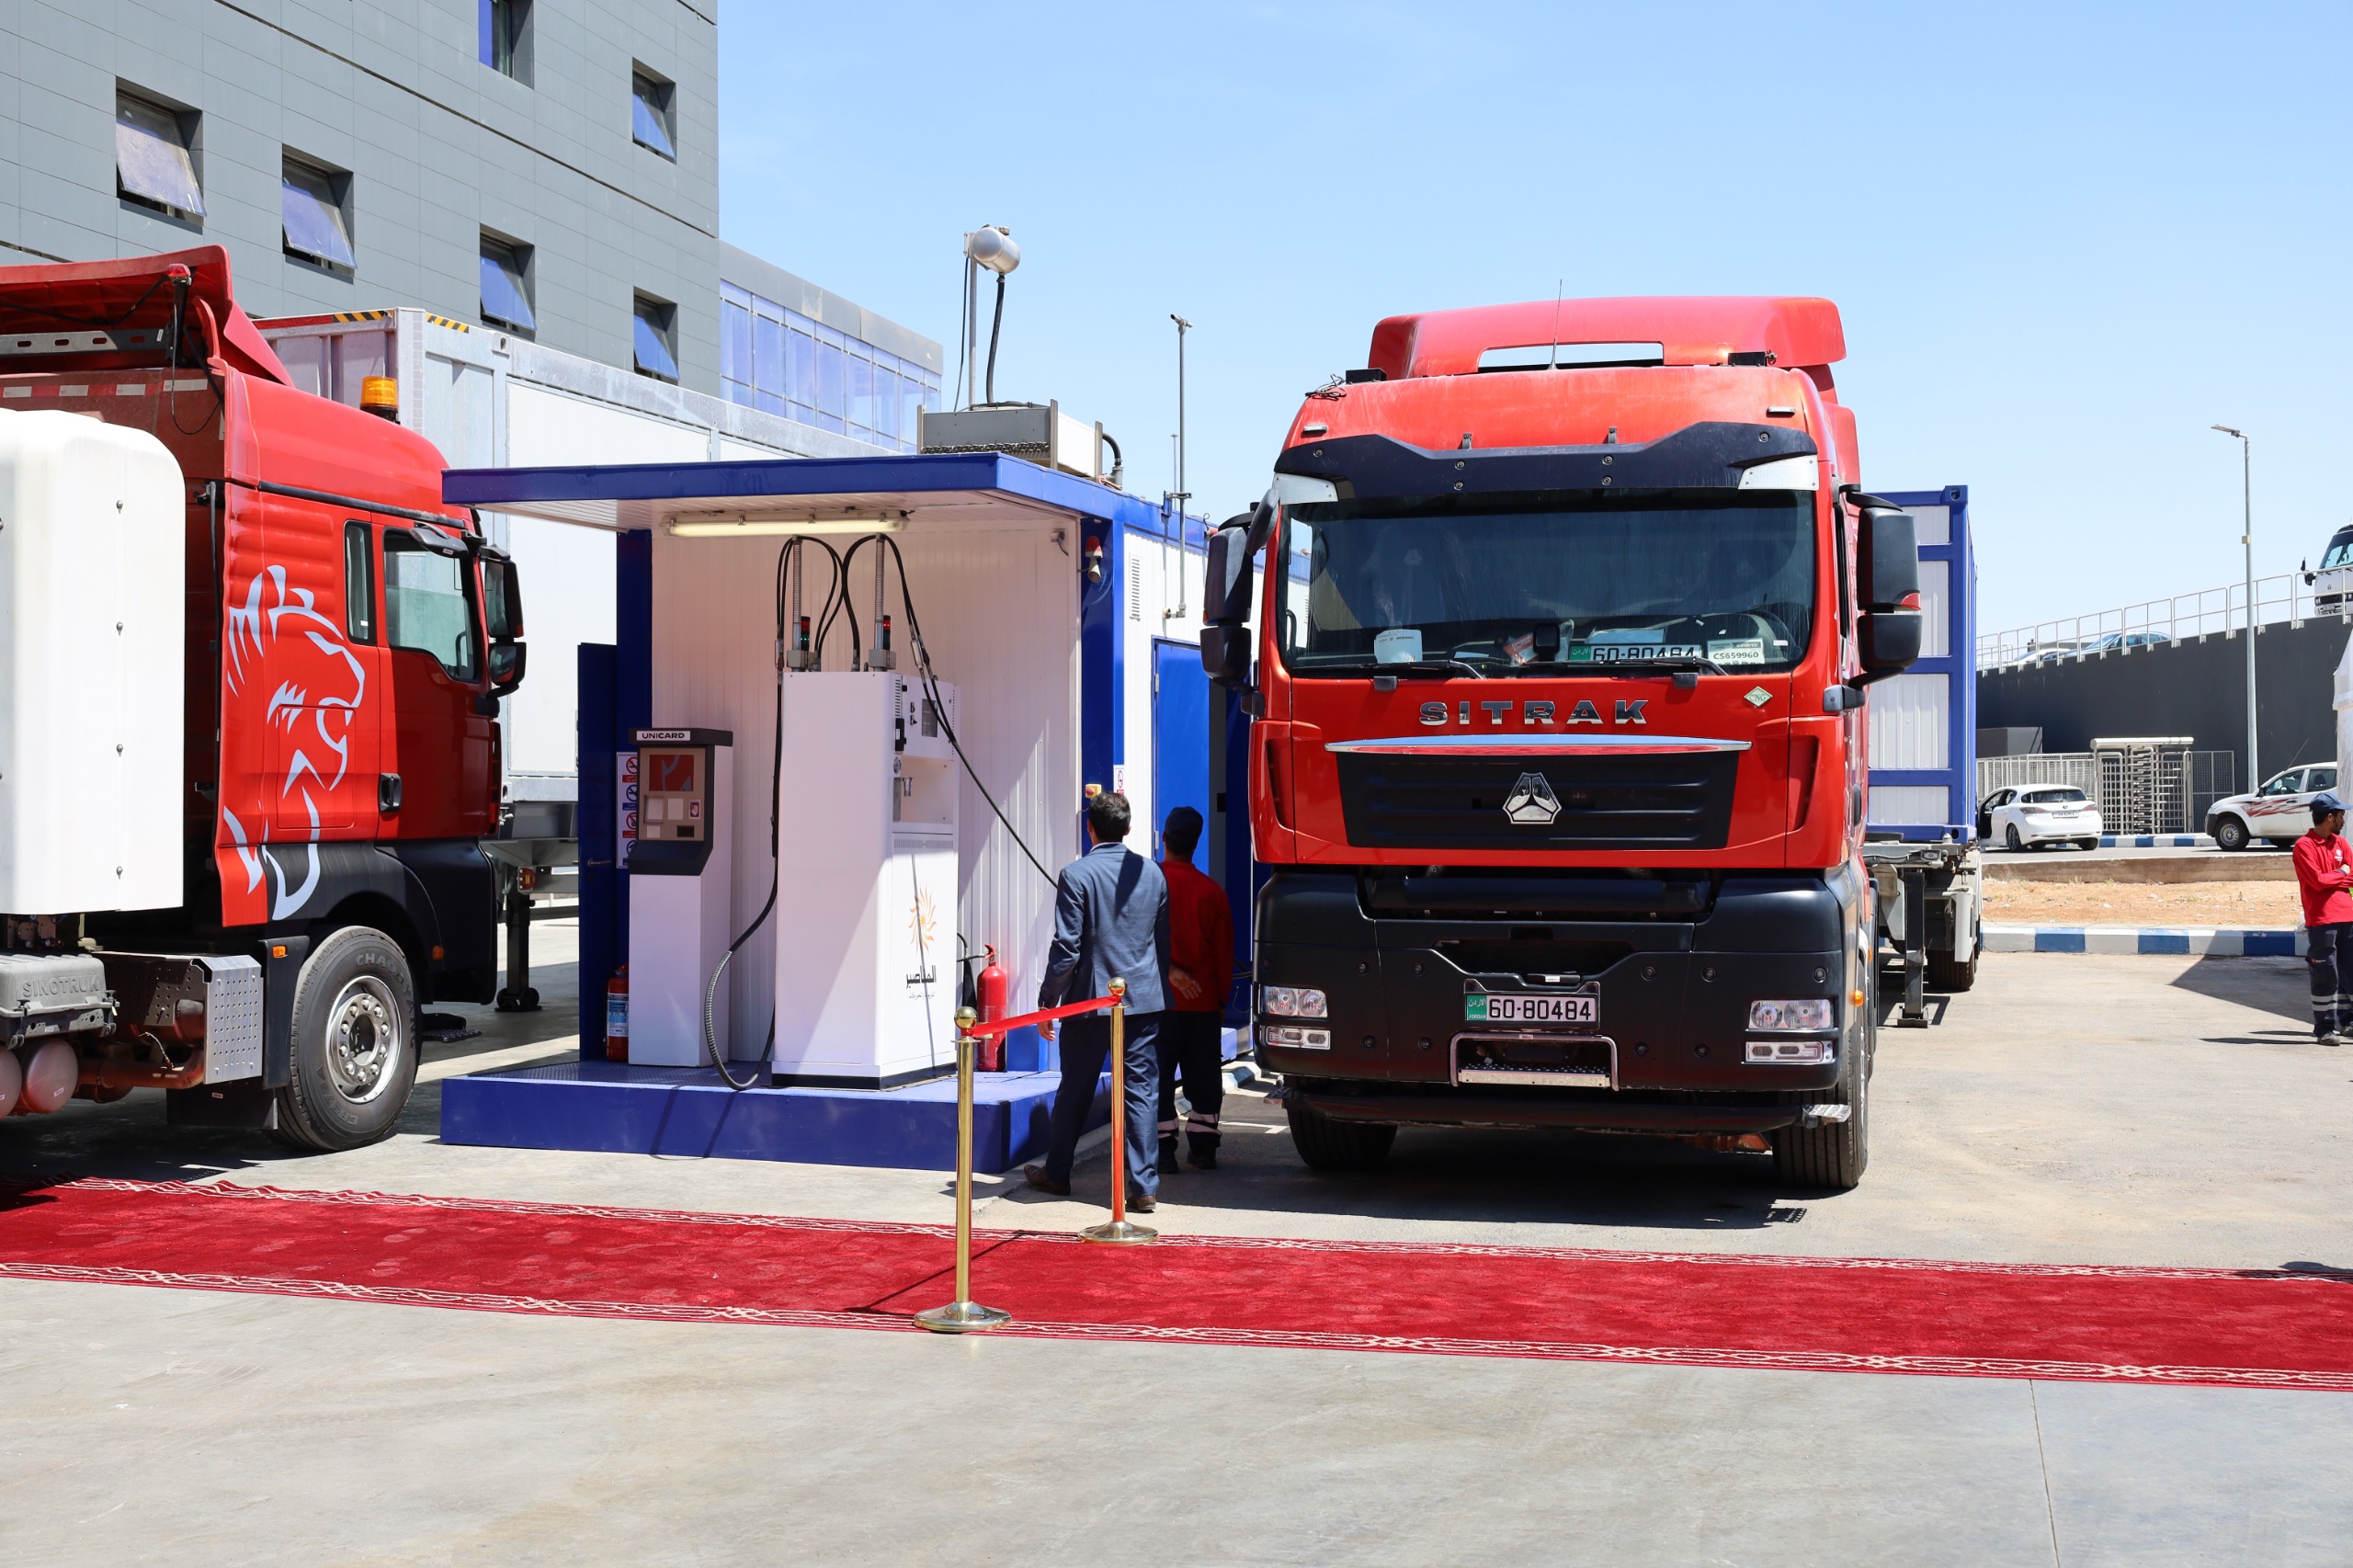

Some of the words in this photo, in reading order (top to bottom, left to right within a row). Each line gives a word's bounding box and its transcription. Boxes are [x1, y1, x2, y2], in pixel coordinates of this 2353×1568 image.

[1713, 652, 1759, 660] CS659960
[1749, 693, 1767, 702] CNG
[1418, 699, 1649, 726] SITRAK
[22, 974, 101, 998] SINOTRUK
[1489, 998, 1592, 1020] 60-80484
